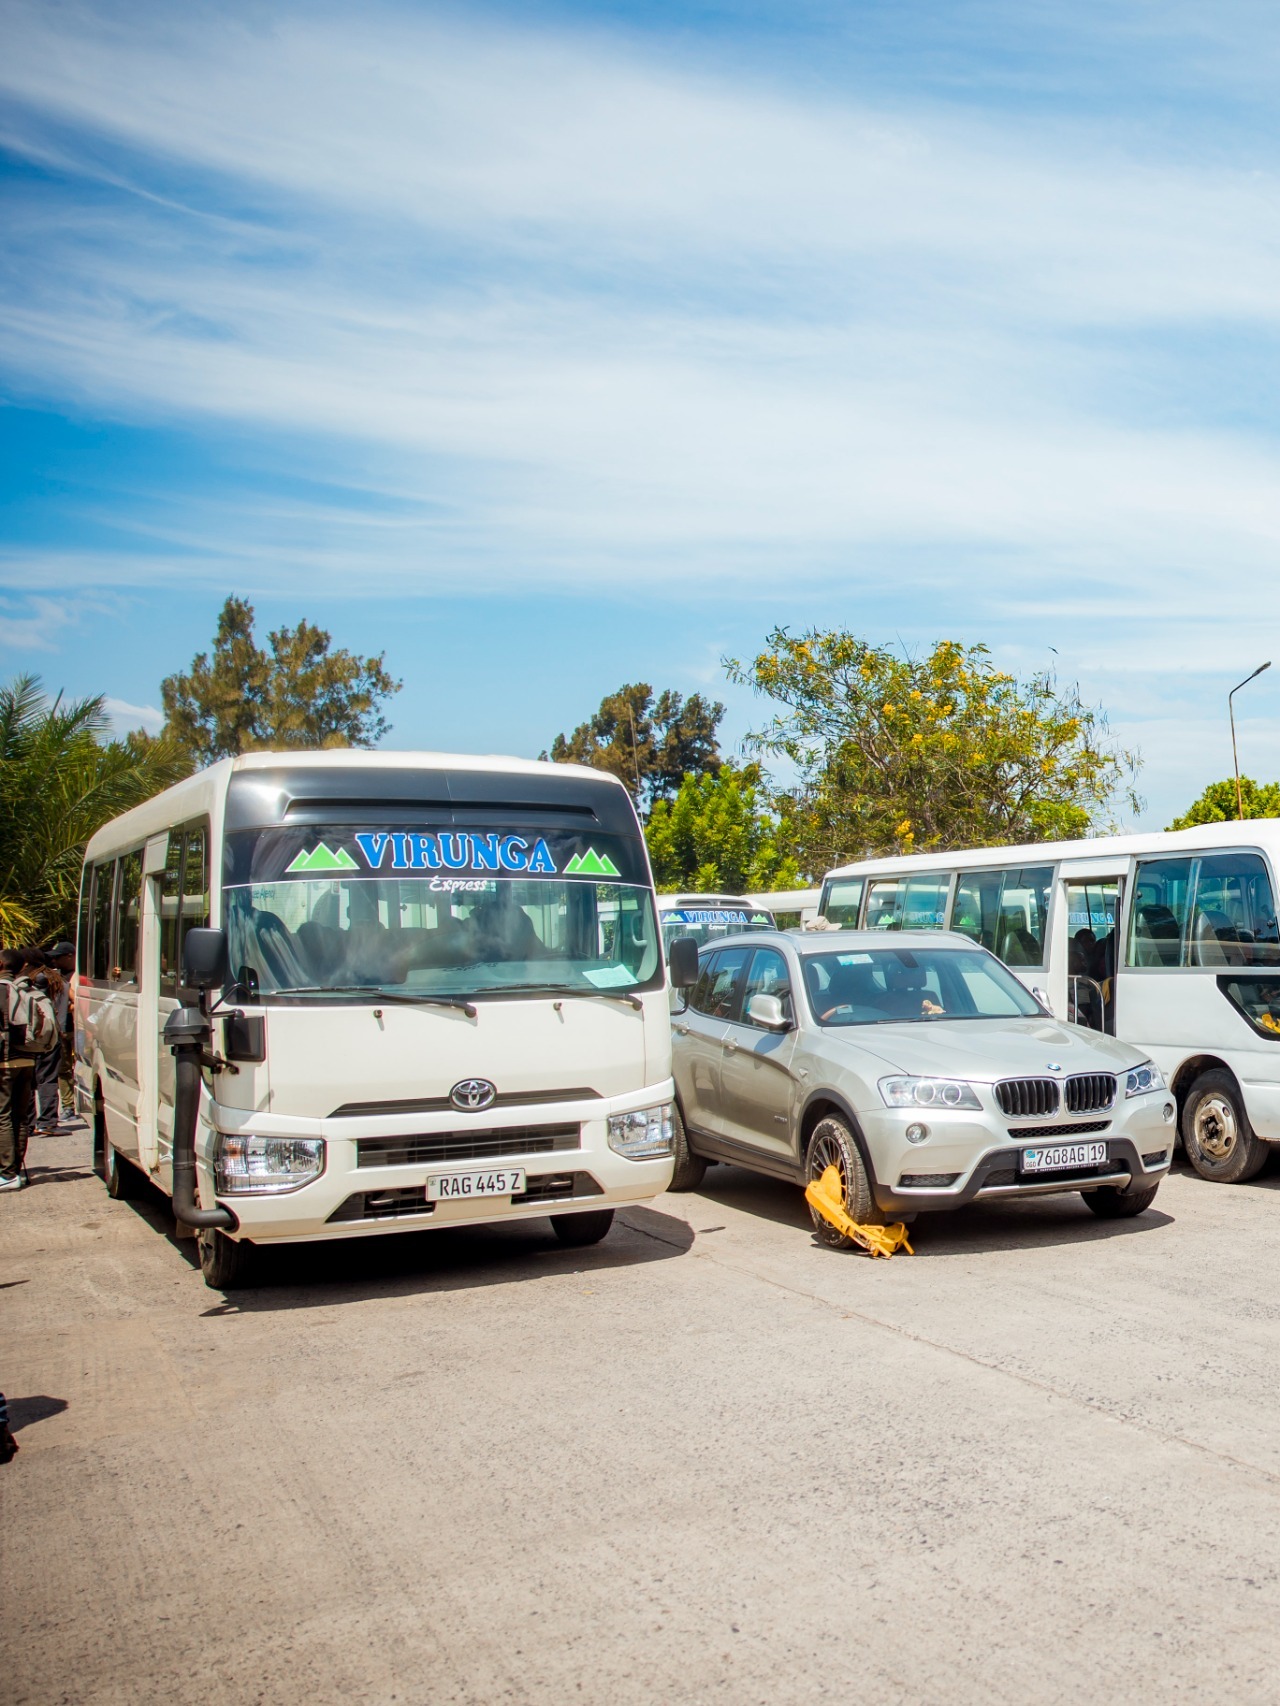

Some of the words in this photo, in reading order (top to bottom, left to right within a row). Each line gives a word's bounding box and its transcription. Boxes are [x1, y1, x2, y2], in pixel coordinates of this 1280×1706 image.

[355, 833, 556, 873] VIRUNGA
[429, 875, 487, 893] Express
[684, 910, 748, 923] VIRUNGA
[1037, 1146, 1085, 1167] 7608AG
[1091, 1144, 1105, 1161] 19
[440, 1176, 472, 1197] RAG
[476, 1174, 506, 1193] 445
[510, 1172, 521, 1190] Z
